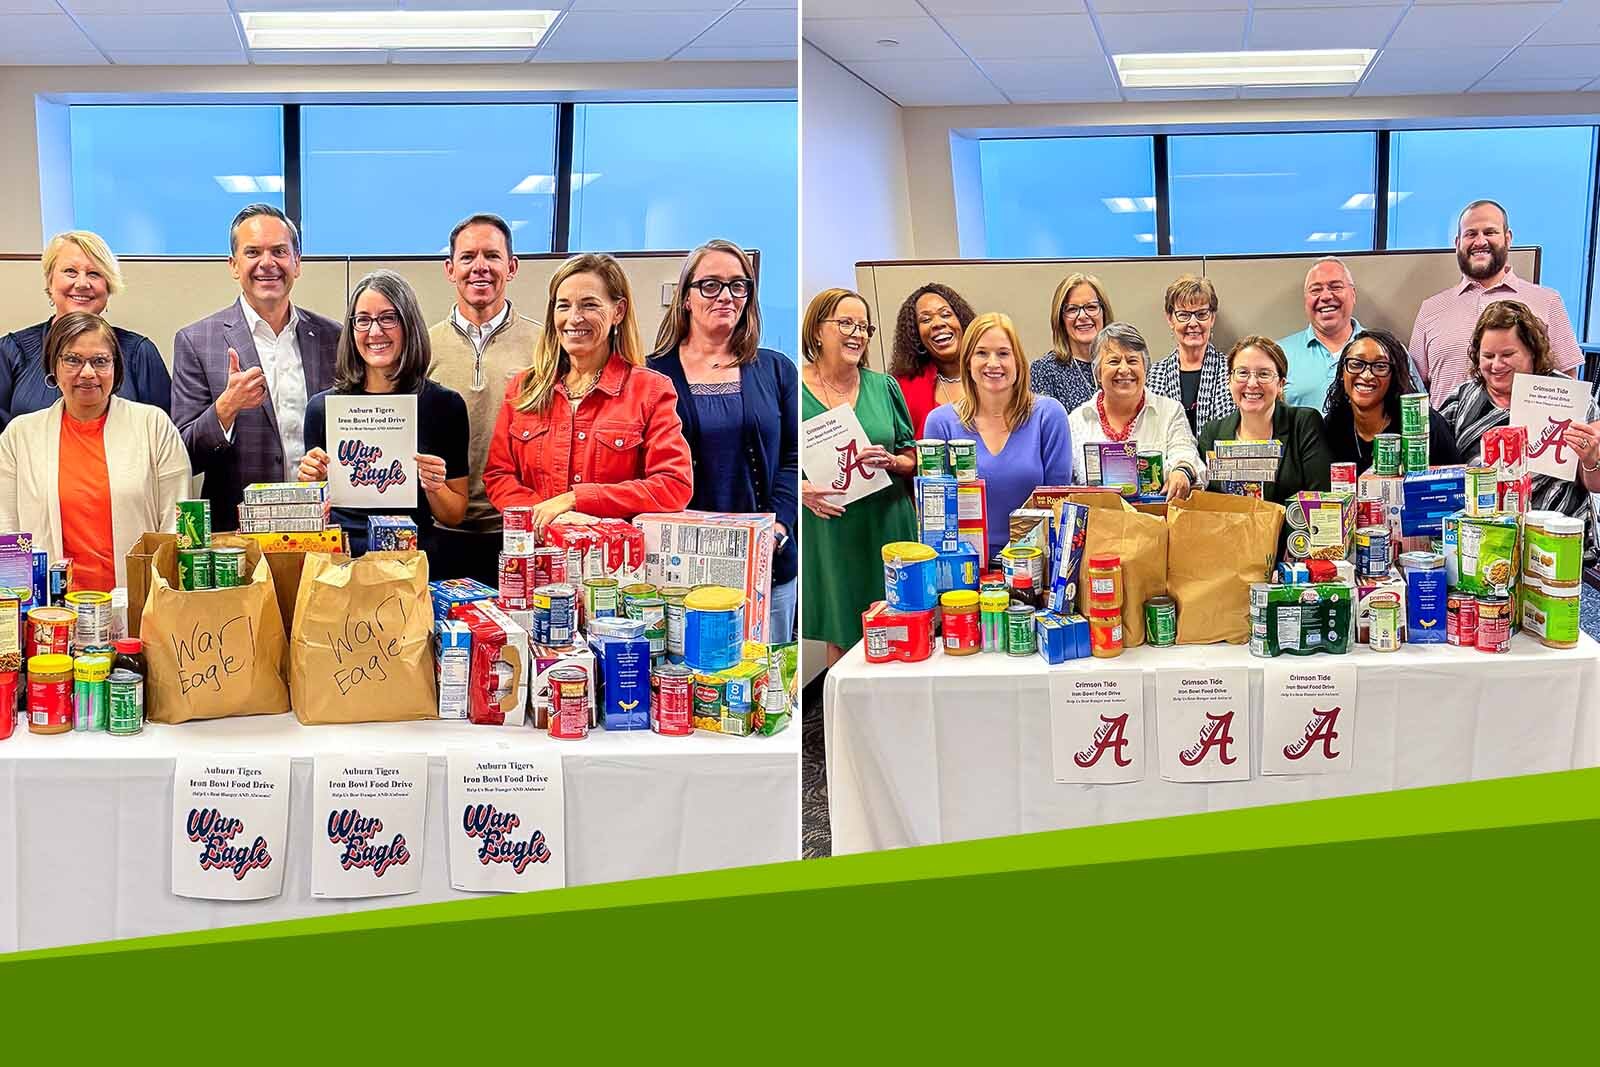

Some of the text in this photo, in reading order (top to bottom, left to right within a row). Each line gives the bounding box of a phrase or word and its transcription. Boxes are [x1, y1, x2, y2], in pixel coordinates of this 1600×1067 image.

[388, 416, 406, 424] Drive
[338, 440, 382, 466] War
[350, 459, 406, 494] Eagle
[1294, 536, 1305, 548] 4
[1104, 680, 1117, 688] Tide
[1290, 674, 1316, 682] Crimson
[731, 686, 740, 694] 8
[1074, 713, 1132, 768] A
[1179, 710, 1237, 766] A
[1283, 707, 1341, 760] A
[204, 766, 262, 776] Auburn Tigers
[342, 767, 399, 776] Auburn Tigers
[476, 762, 534, 771] Auburn Tigers
[190, 780, 274, 790] Iron Bowl Food Drive
[329, 780, 412, 788] Iron Bowl Food Drive
[464, 774, 548, 783] Iron Bowl Food Drive
[187, 808, 244, 843] War
[328, 809, 383, 844] War
[464, 804, 520, 838] War
[200, 833, 272, 880] Eagle
[340, 834, 410, 878] Eagle
[478, 828, 552, 874] Eagle
